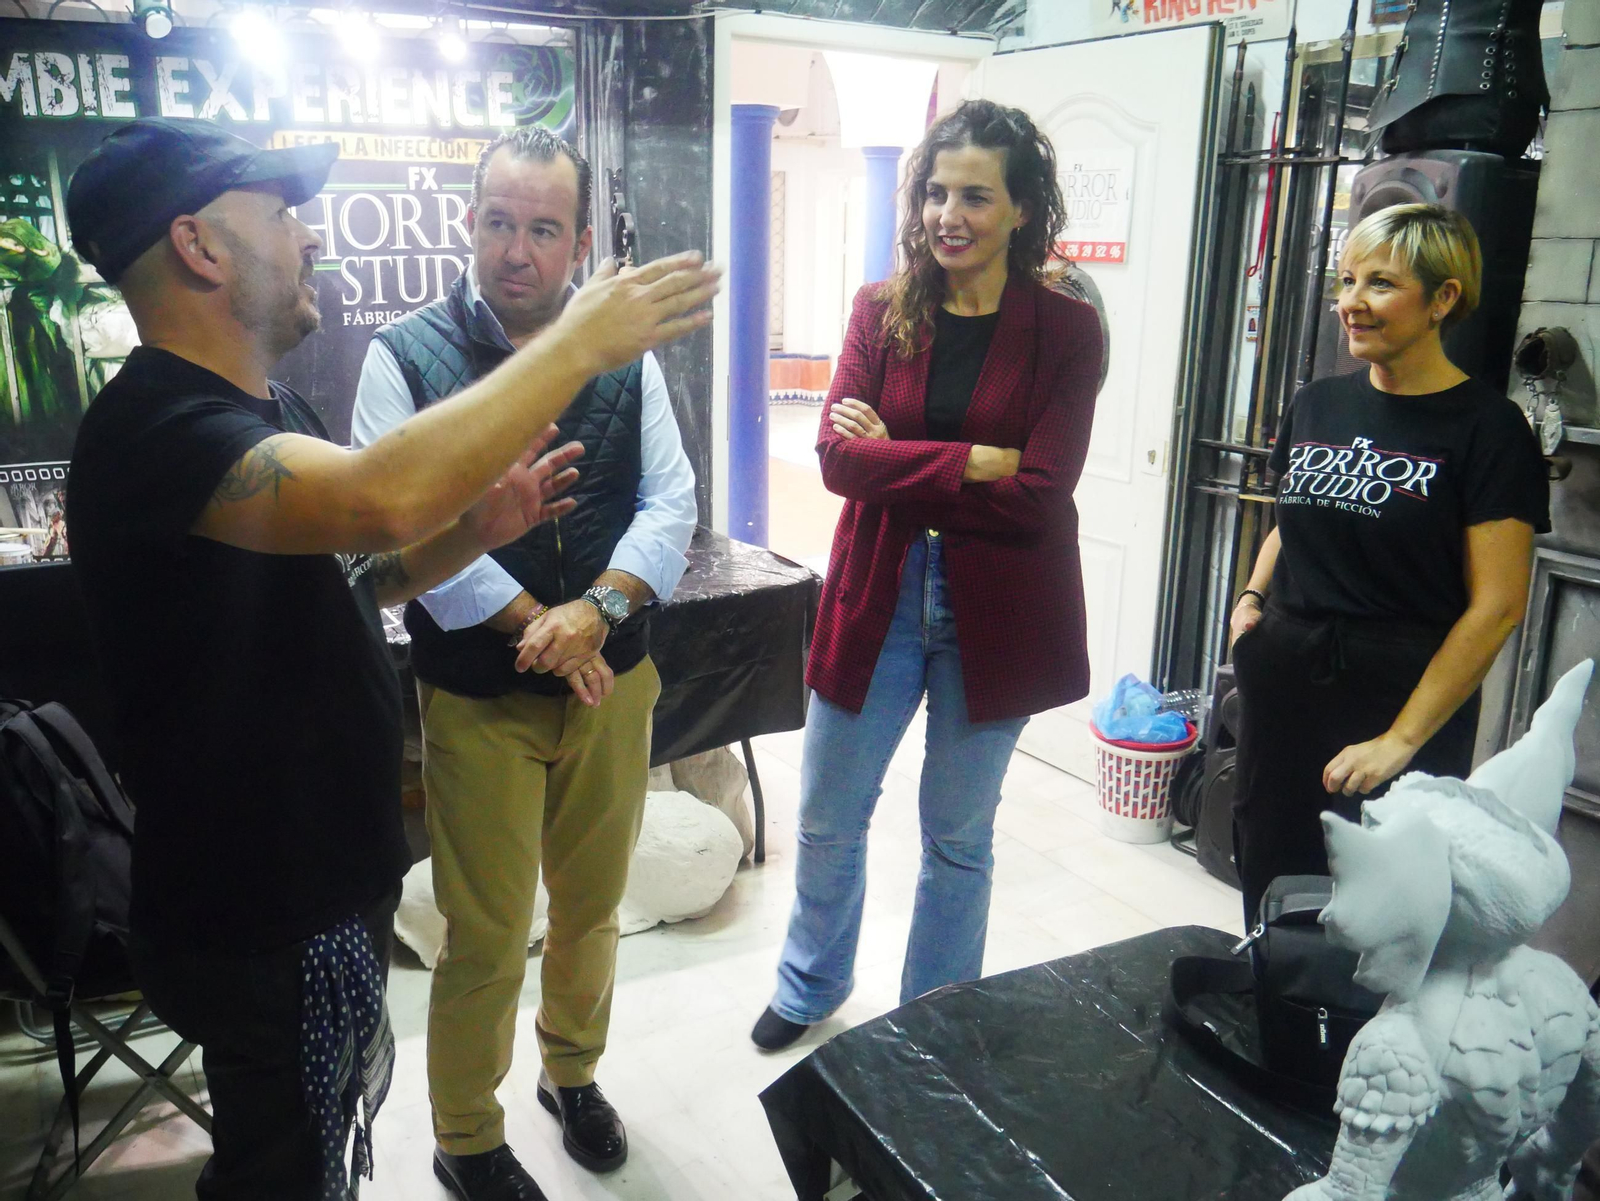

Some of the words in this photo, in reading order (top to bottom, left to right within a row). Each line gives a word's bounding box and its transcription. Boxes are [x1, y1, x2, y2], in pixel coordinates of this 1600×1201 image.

[156, 55, 516, 127] EXPERIENCE
[342, 137, 369, 157] LA
[408, 166, 439, 190] FX
[1074, 164, 1083, 173] FX
[1056, 173, 1118, 200] ORROR
[1064, 199, 1102, 221] UDIO
[290, 193, 473, 260] HORR
[341, 254, 475, 306] STUD
[1351, 436, 1373, 449] FX
[1288, 446, 1437, 496] HORROR
[1282, 471, 1392, 505] STUDIO
[1279, 496, 1311, 506] FÁBRICA
[1316, 498, 1330, 508] DE
[1334, 501, 1382, 519] FICCIÓN
